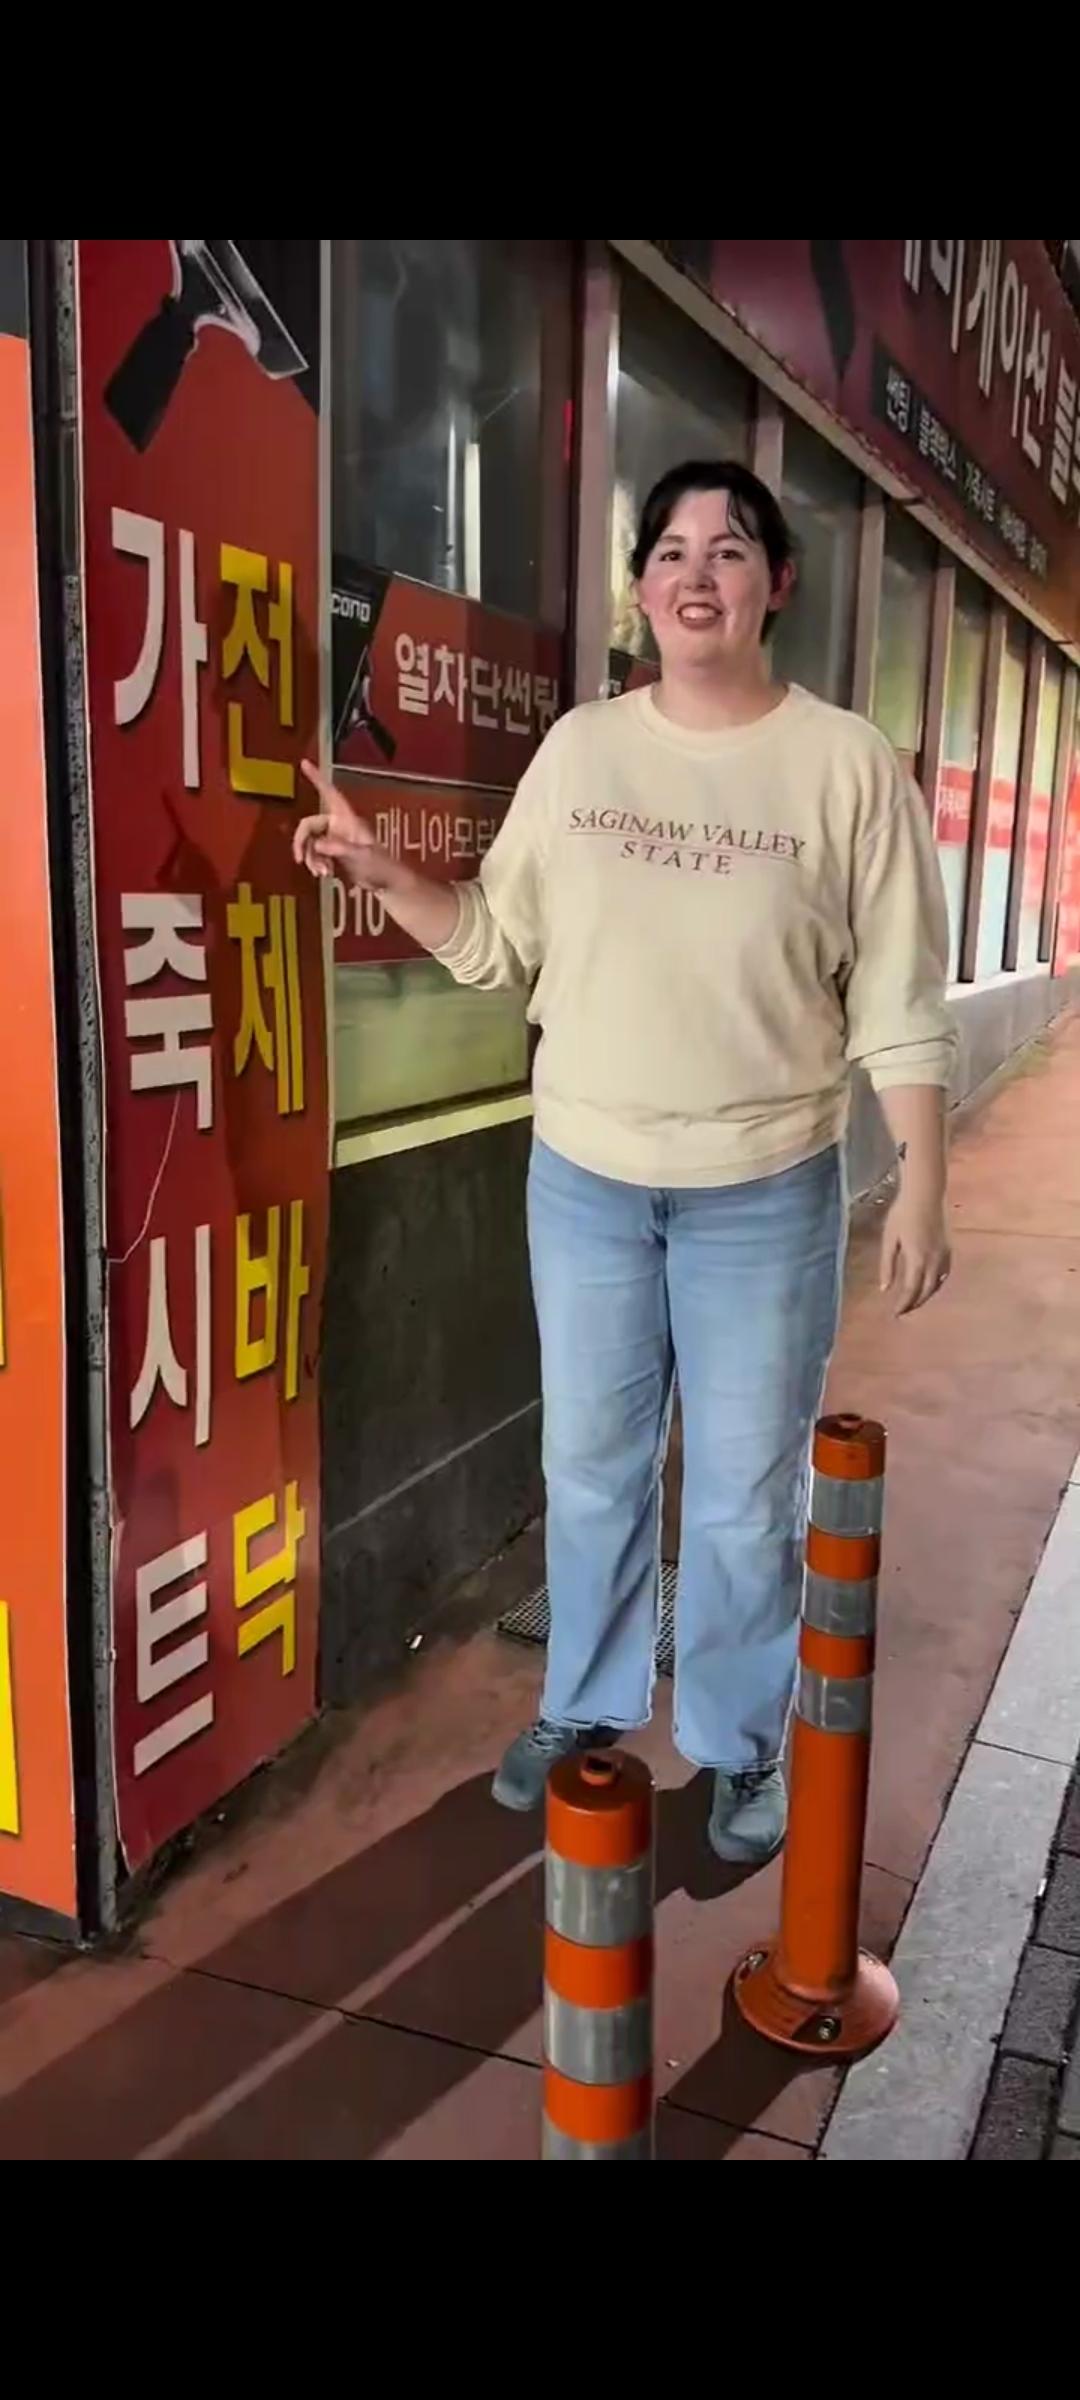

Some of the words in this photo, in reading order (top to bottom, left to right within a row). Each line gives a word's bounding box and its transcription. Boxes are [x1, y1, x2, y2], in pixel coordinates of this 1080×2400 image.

[221, 543, 309, 1676] 전체바닥
[569, 808, 694, 841] SAGINAW
[703, 824, 806, 860] VALLEY
[620, 840, 733, 876] STATE
[111, 508, 211, 1776] 가죽시트
